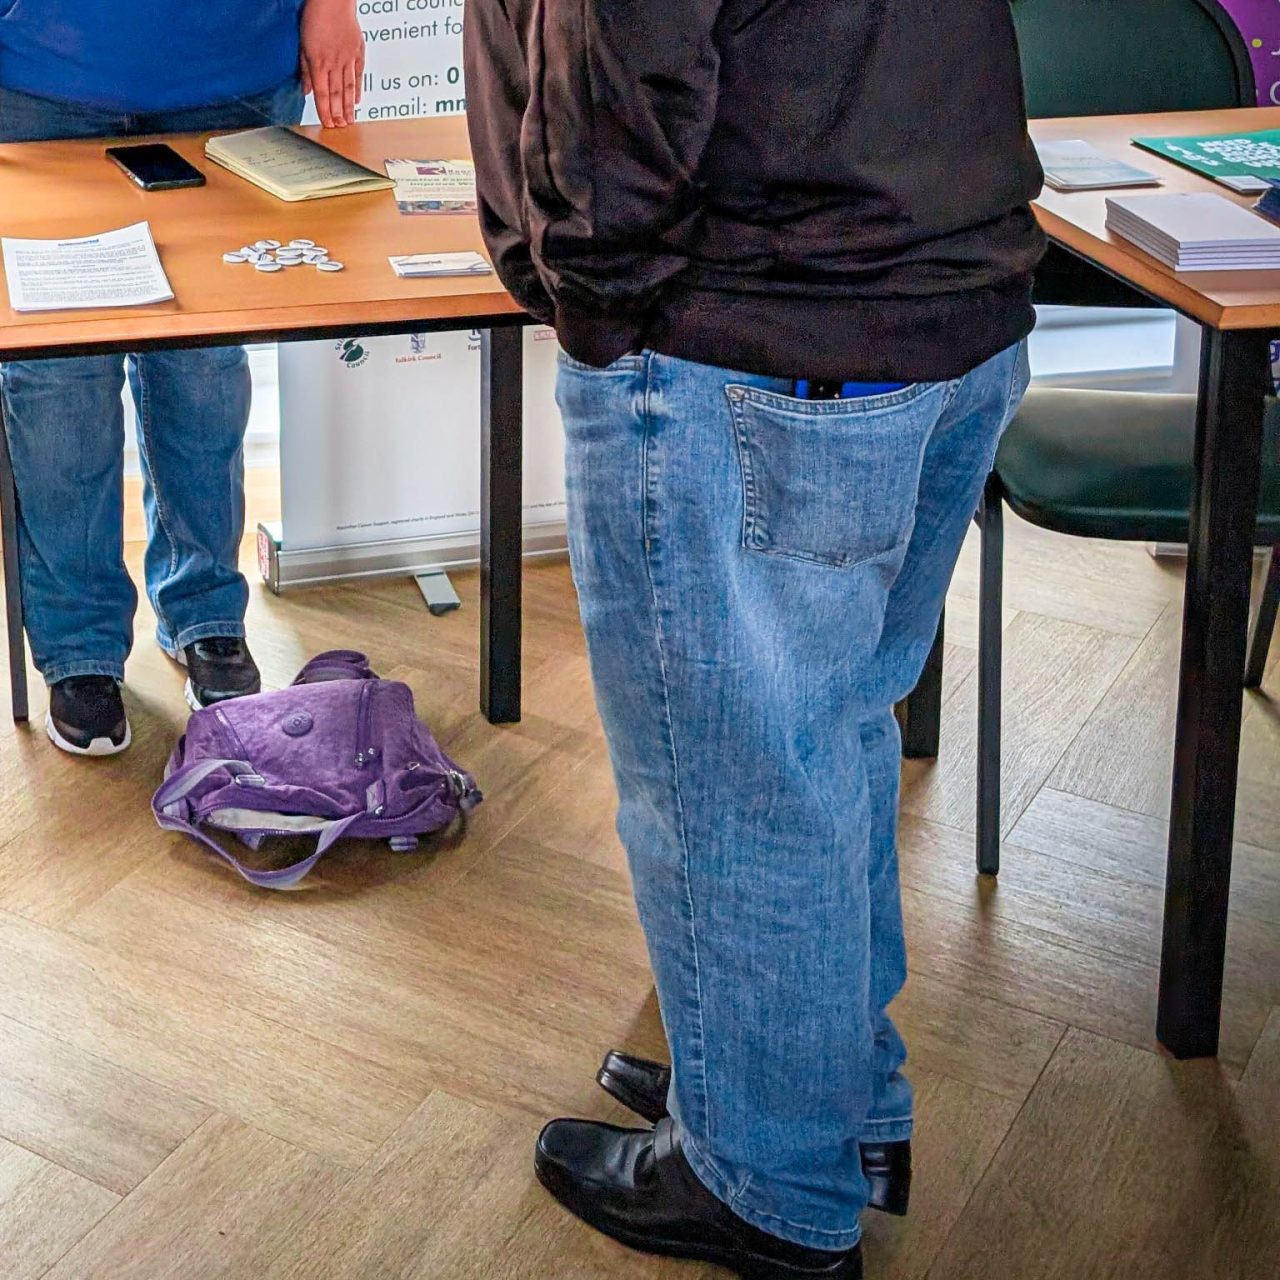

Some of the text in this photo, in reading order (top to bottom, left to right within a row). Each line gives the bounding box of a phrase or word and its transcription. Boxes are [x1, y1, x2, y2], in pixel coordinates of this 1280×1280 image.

[381, 76, 401, 91] us
[408, 73, 438, 89] on:
[368, 95, 427, 120] email:
[417, 352, 442, 361] Council
